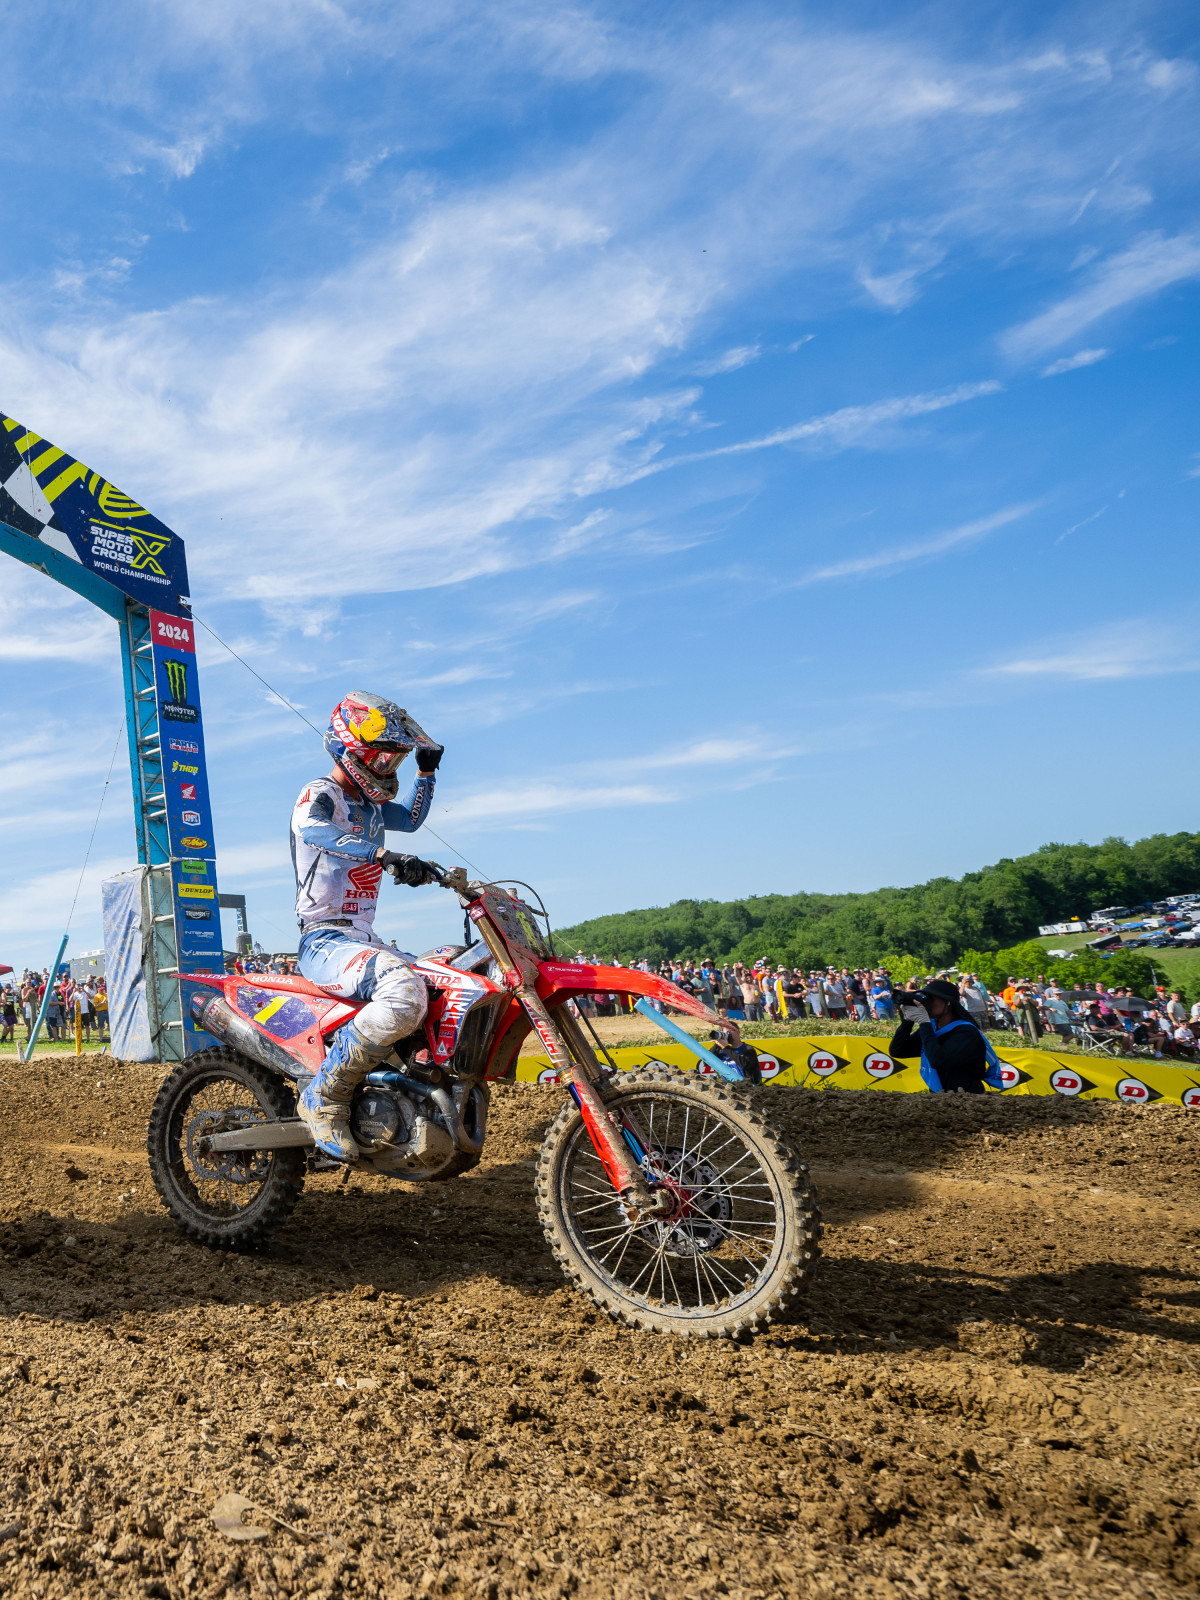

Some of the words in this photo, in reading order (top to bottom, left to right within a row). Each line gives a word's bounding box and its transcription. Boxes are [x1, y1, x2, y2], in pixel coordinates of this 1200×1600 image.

[90, 525, 134, 546] SUPER
[93, 536, 133, 554] MOTO
[91, 545, 135, 564] CROSS
[93, 560, 120, 573] WORLD
[120, 567, 172, 586] CHAMPIONSHIP
[158, 622, 190, 643] 2024
[164, 704, 196, 717] MONSTER
[179, 764, 199, 774] THOR
[411, 785, 425, 826] HONDA
[344, 889, 379, 900] HON
[250, 975, 294, 985] HONDA
[419, 974, 463, 986] ONDA
[253, 995, 292, 1025] 1
[369, 1101, 377, 1116] 1
